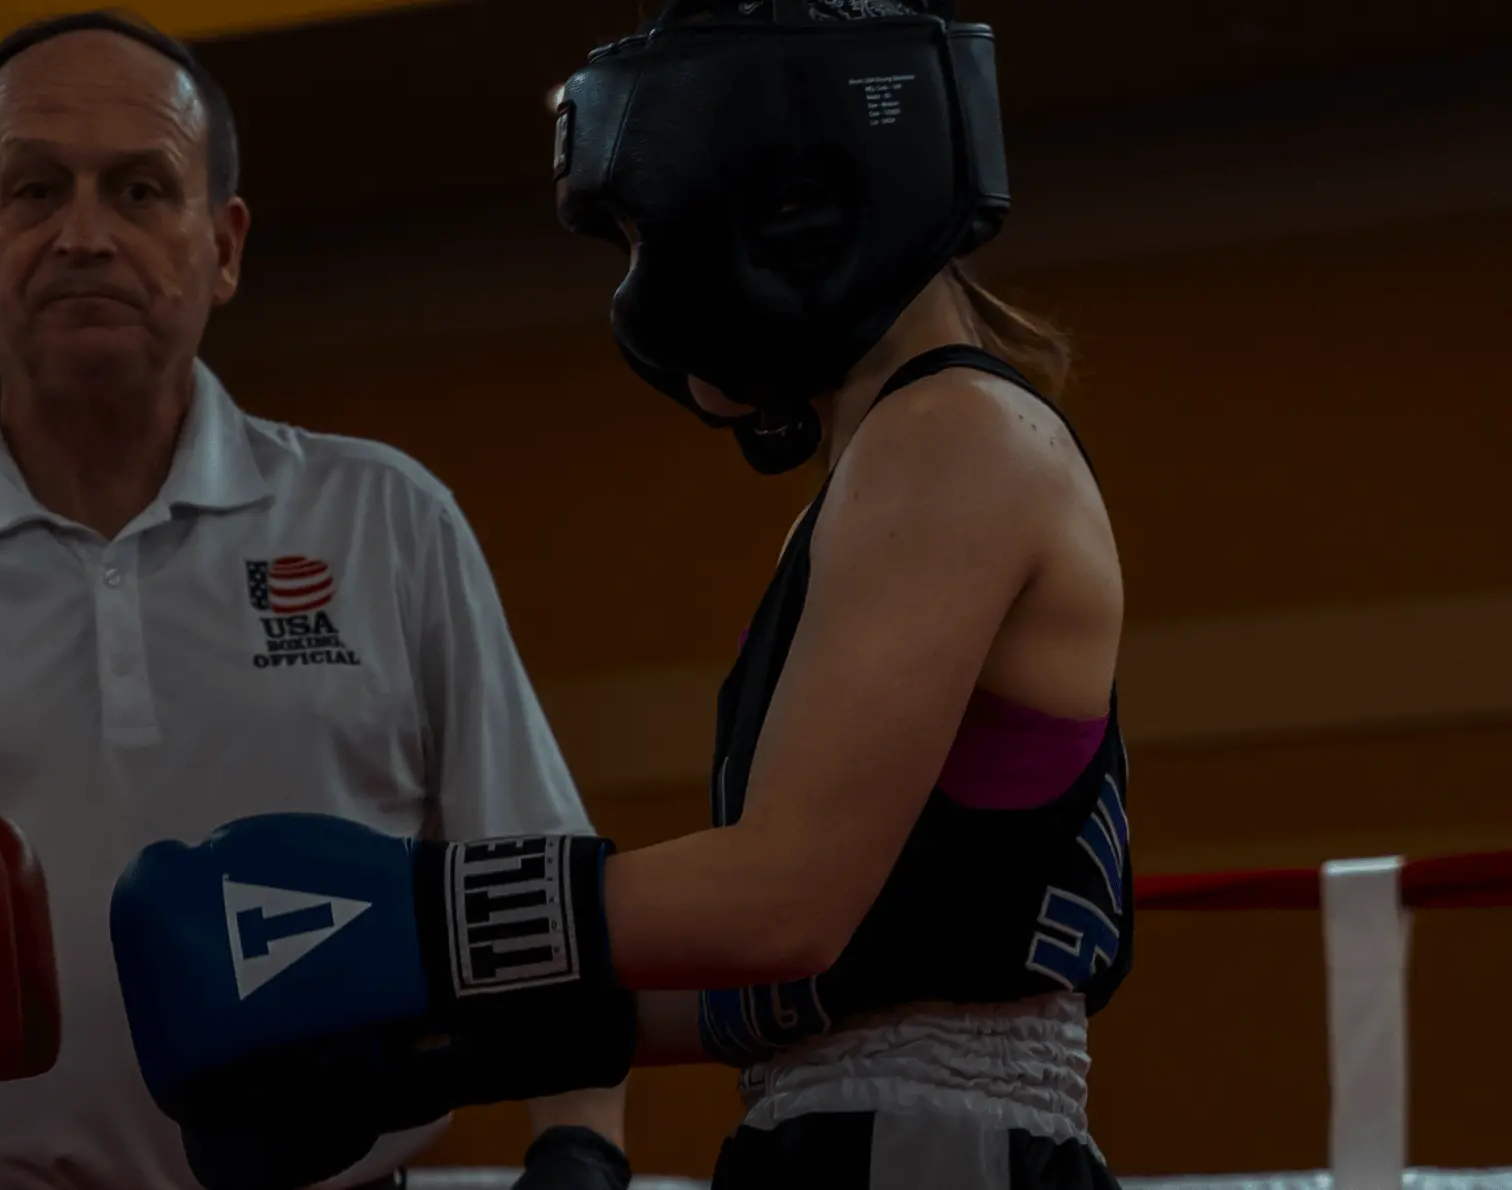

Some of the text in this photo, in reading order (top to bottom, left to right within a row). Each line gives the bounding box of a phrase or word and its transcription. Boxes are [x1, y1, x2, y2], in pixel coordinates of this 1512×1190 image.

[261, 611, 338, 637] USA
[253, 651, 360, 668] OFFICIAL
[464, 838, 553, 979] TITLE
[236, 902, 335, 960] T
